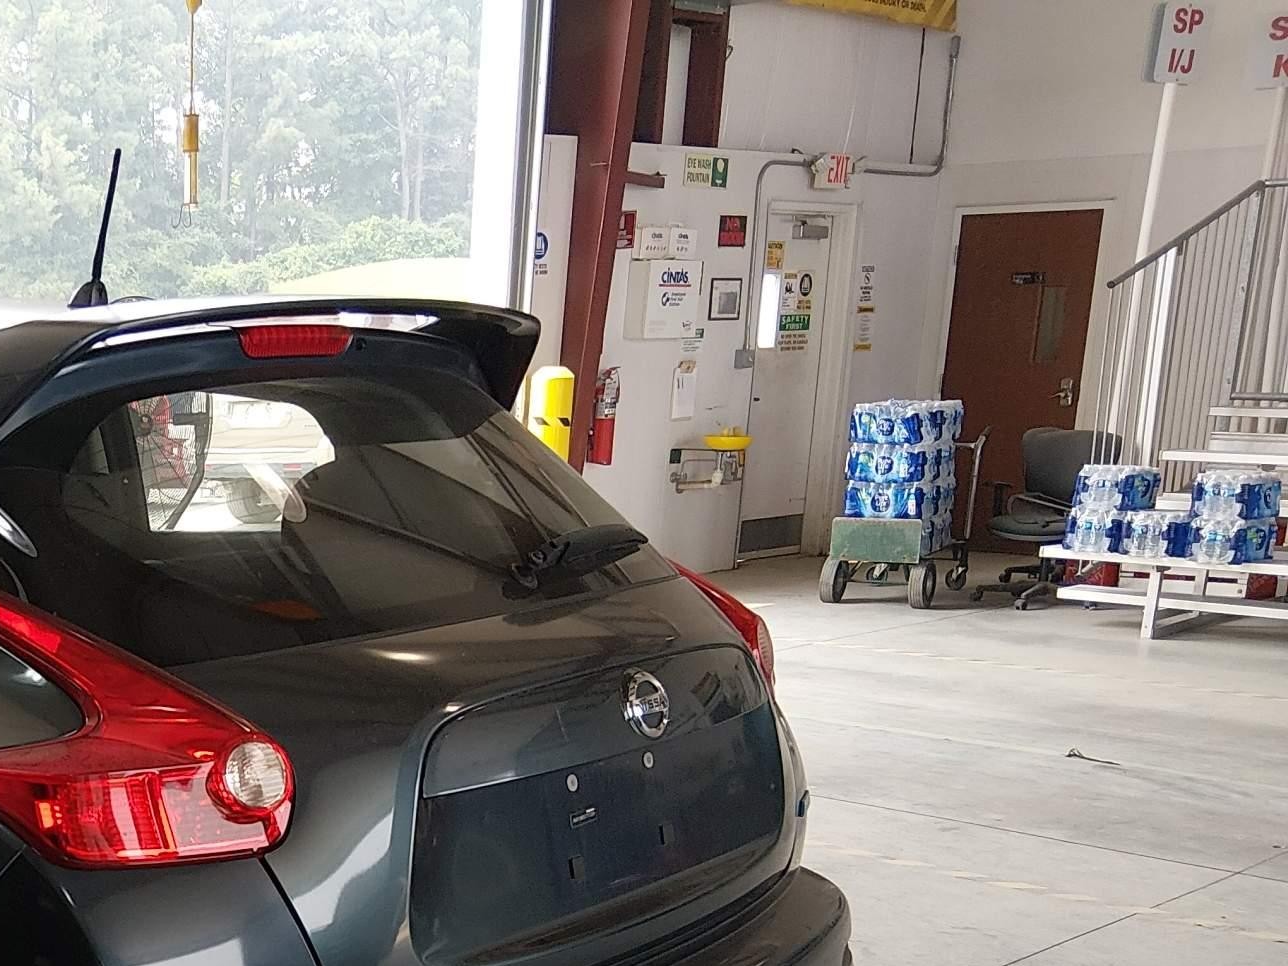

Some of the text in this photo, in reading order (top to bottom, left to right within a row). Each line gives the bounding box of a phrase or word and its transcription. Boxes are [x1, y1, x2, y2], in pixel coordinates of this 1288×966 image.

[1173, 8, 1204, 34] SP
[1168, 48, 1195, 74] I/J
[687, 157, 712, 170] EYE WASH
[827, 154, 851, 184] EXIT
[686, 171, 710, 183] FOUNTAIN
[661, 267, 689, 284] CINTAS
[781, 315, 809, 324] SAFETY
